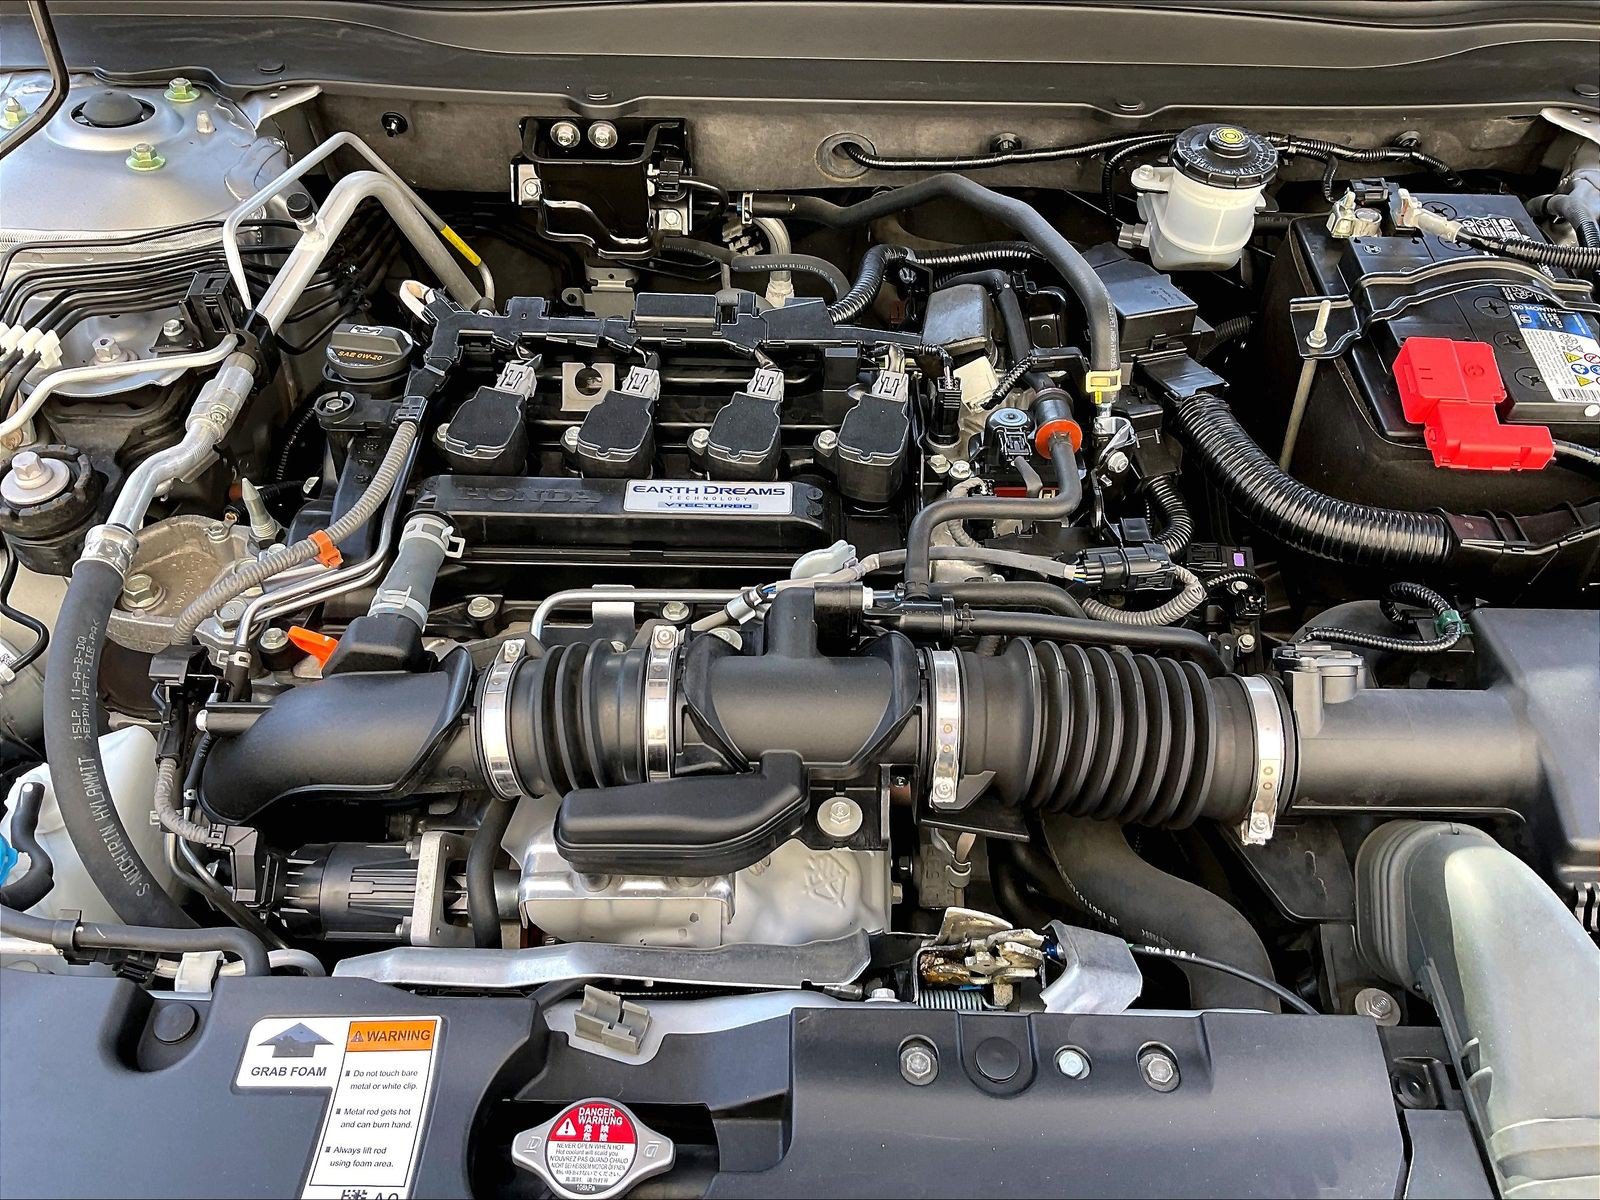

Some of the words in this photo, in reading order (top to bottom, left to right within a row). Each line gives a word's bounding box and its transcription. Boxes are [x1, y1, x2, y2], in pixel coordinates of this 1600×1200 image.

[337, 350, 356, 358] SAE
[357, 352, 383, 361] 0W-20
[456, 487, 601, 503] HONDA
[632, 485, 699, 494] EARTH
[704, 486, 785, 496] DREAMS
[77, 757, 111, 822] HYLAMMIT
[367, 1030, 431, 1042] WARNING
[251, 1067, 287, 1077] GRAB
[290, 1067, 327, 1077] FOAM
[353, 1069, 364, 1077] Do
[380, 1069, 400, 1077] touch
[350, 1082, 371, 1090] metal
[382, 1082, 402, 1090] white
[403, 1082, 418, 1091] clip.
[380, 1108, 397, 1117] gets
[578, 1107, 615, 1117] DANGER
[340, 1121, 355, 1129] and
[372, 1121, 390, 1129] burn
[391, 1121, 413, 1129] hand.
[578, 1116, 623, 1125] WARNUNG
[333, 1146, 361, 1155] Always
[362, 1146, 372, 1154] lift
[330, 1160, 351, 1168] using
[352, 1160, 373, 1168] foam
[374, 1160, 394, 1168] area.
